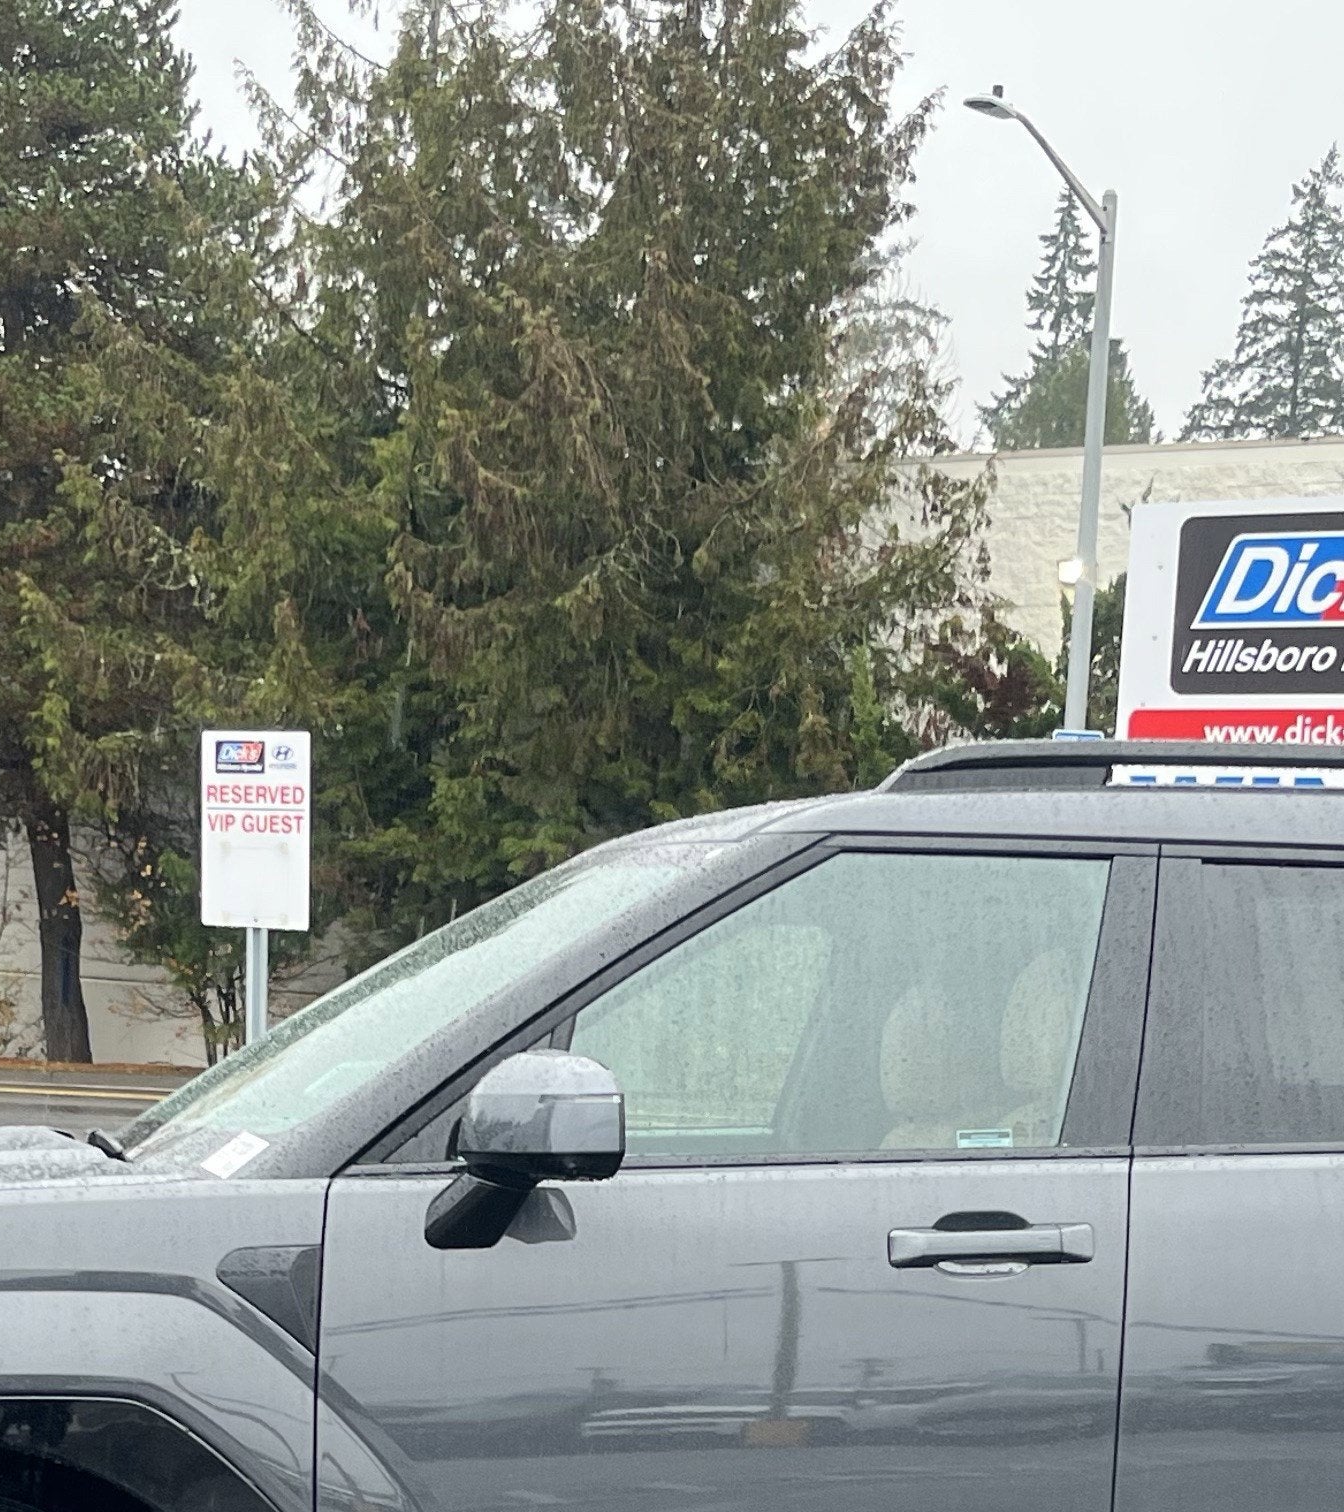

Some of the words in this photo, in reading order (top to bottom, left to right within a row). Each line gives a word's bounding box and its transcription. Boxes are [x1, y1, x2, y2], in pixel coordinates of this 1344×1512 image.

[1181, 638, 1338, 674] Hillsboro
[206, 784, 305, 805] RESERVED
[207, 813, 236, 832] VIP
[241, 814, 305, 835] GUEST
